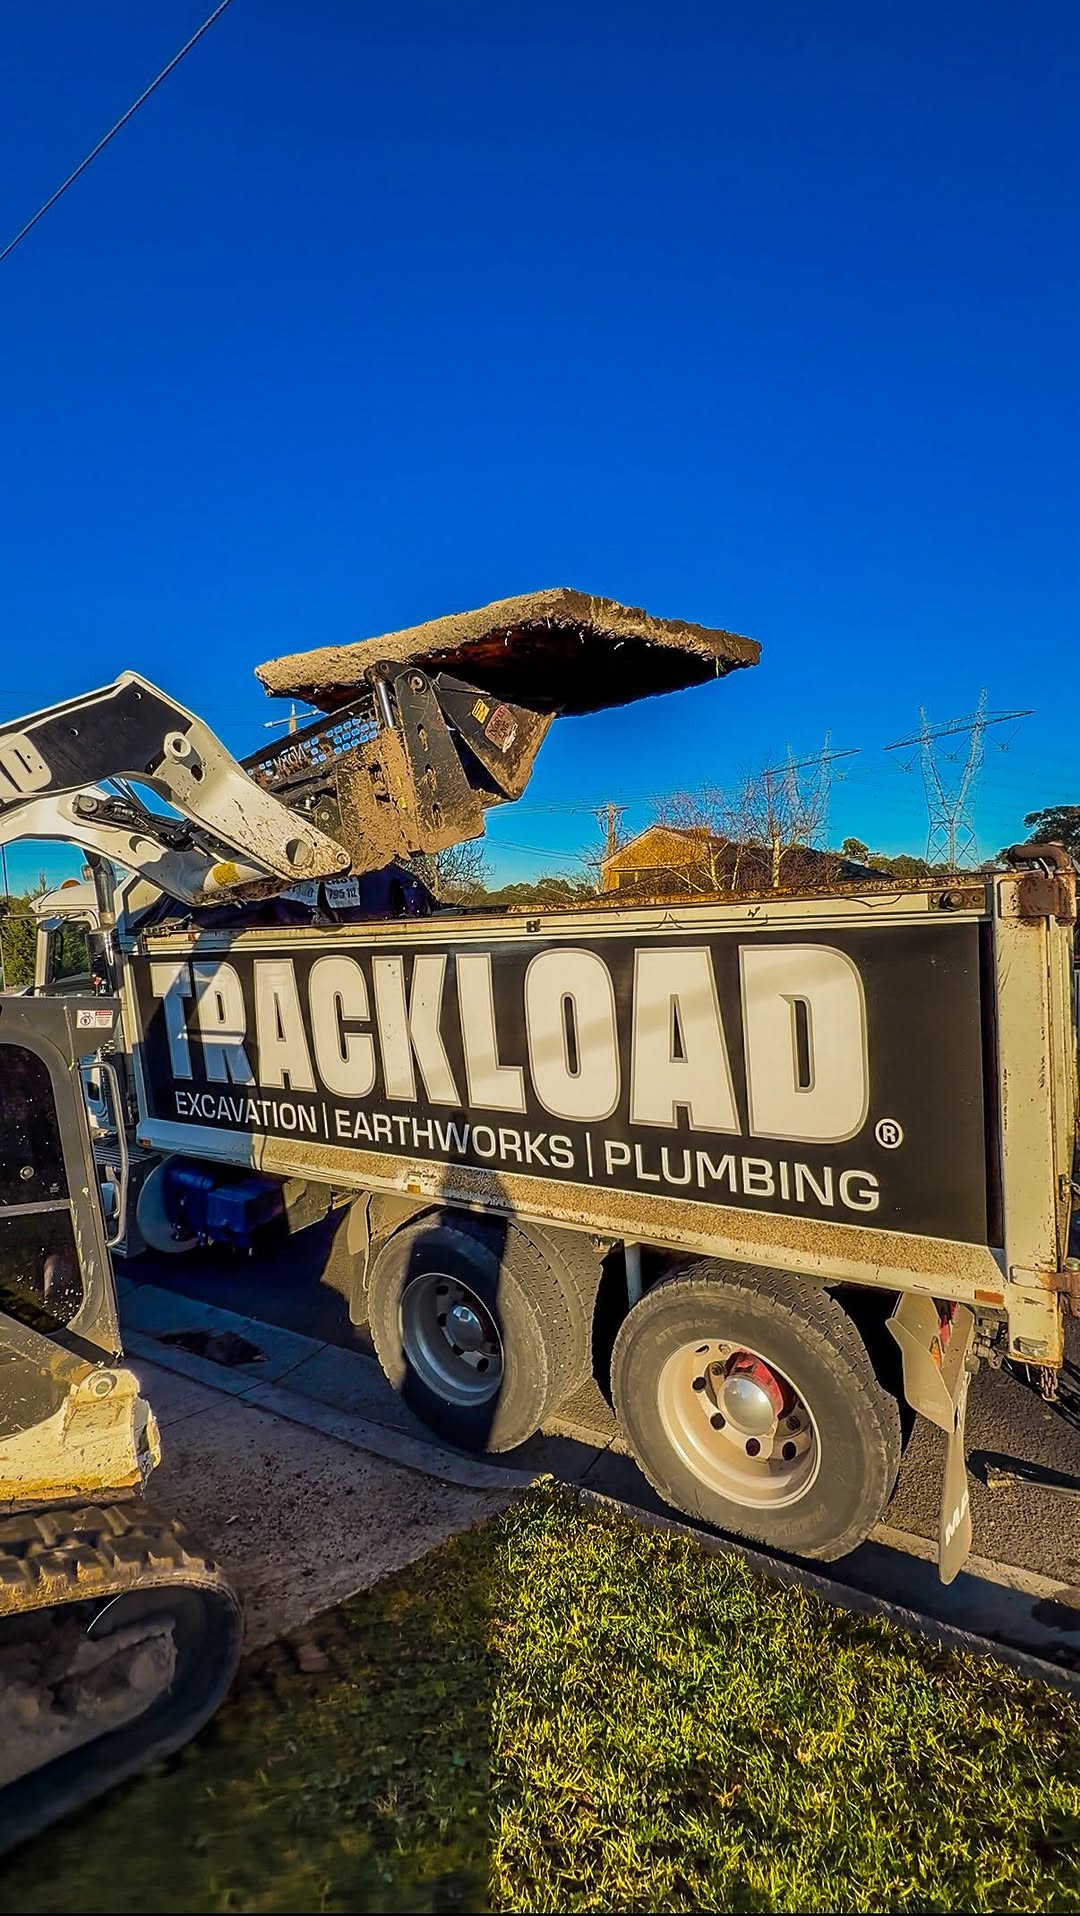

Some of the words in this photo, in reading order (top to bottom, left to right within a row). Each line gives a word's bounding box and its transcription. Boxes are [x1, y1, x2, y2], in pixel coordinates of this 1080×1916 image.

[150, 943, 870, 1144] TRACKLOAD
[174, 1090, 317, 1133] EXCAVATION
[334, 1109, 575, 1170] EARTHWORKS
[603, 1139, 881, 1213] PLUMBING
